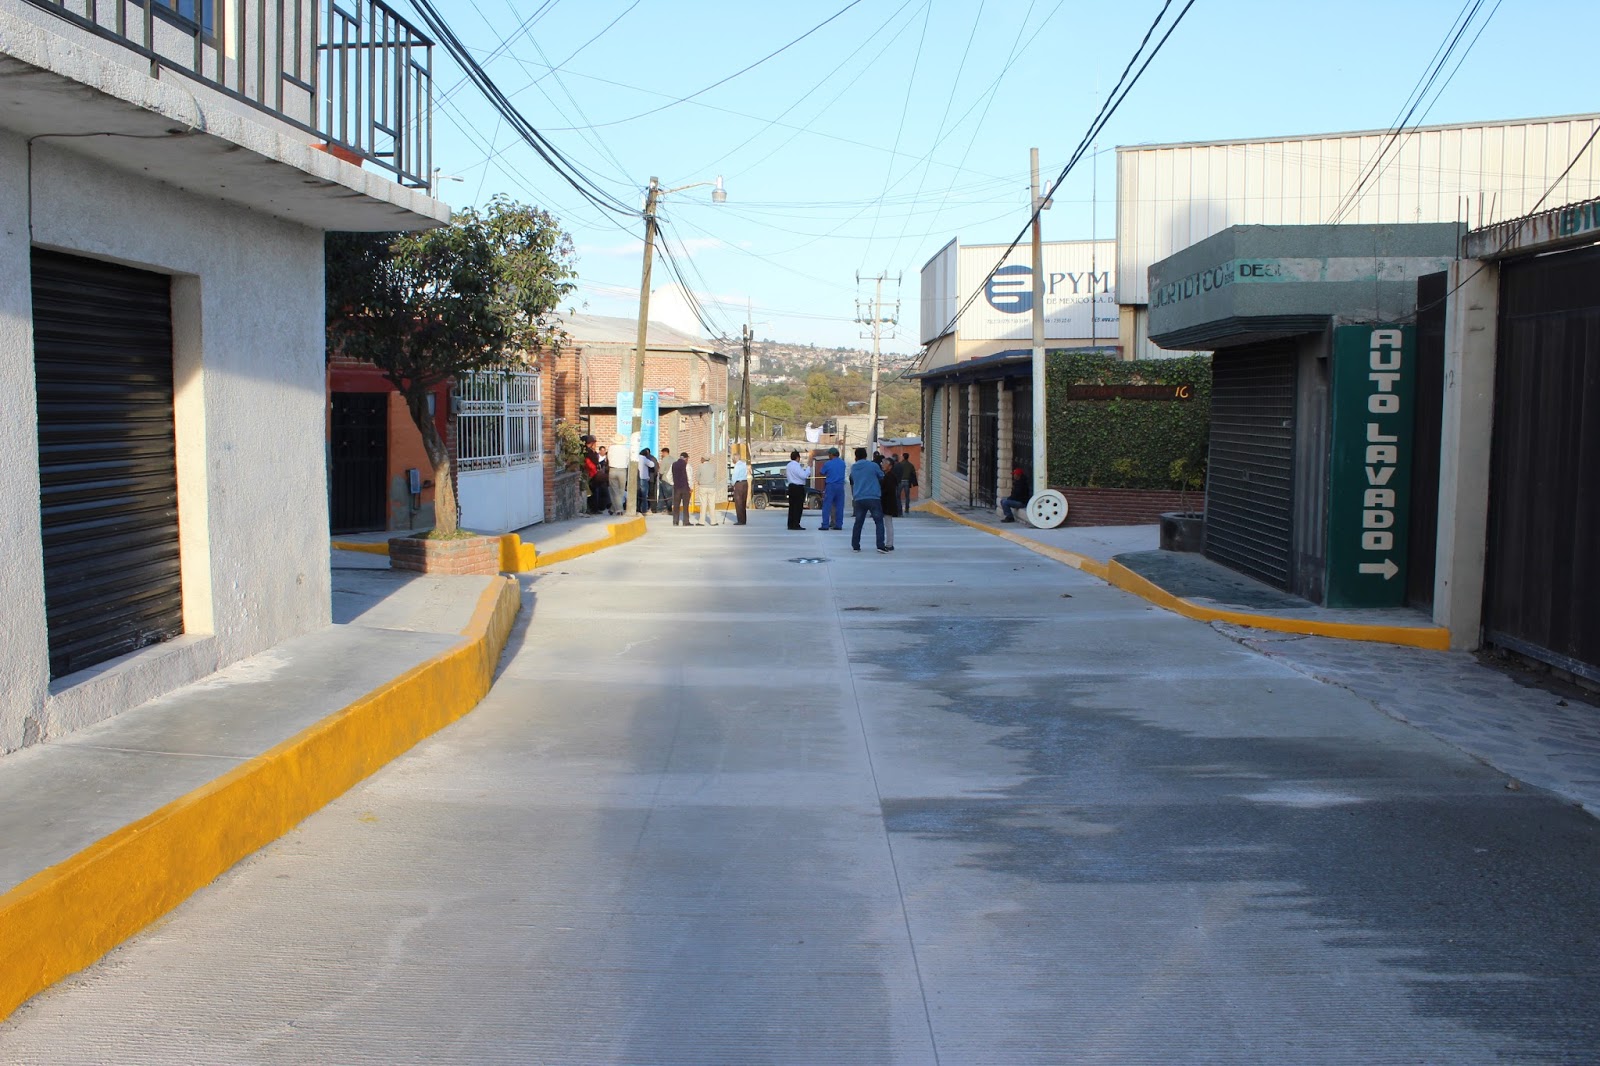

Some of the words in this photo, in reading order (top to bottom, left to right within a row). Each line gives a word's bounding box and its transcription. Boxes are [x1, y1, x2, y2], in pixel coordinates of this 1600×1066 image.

[1048, 271, 1116, 294] PYM
[1368, 329, 1402, 414] AUTO
[1361, 422, 1398, 550] LAVADO
